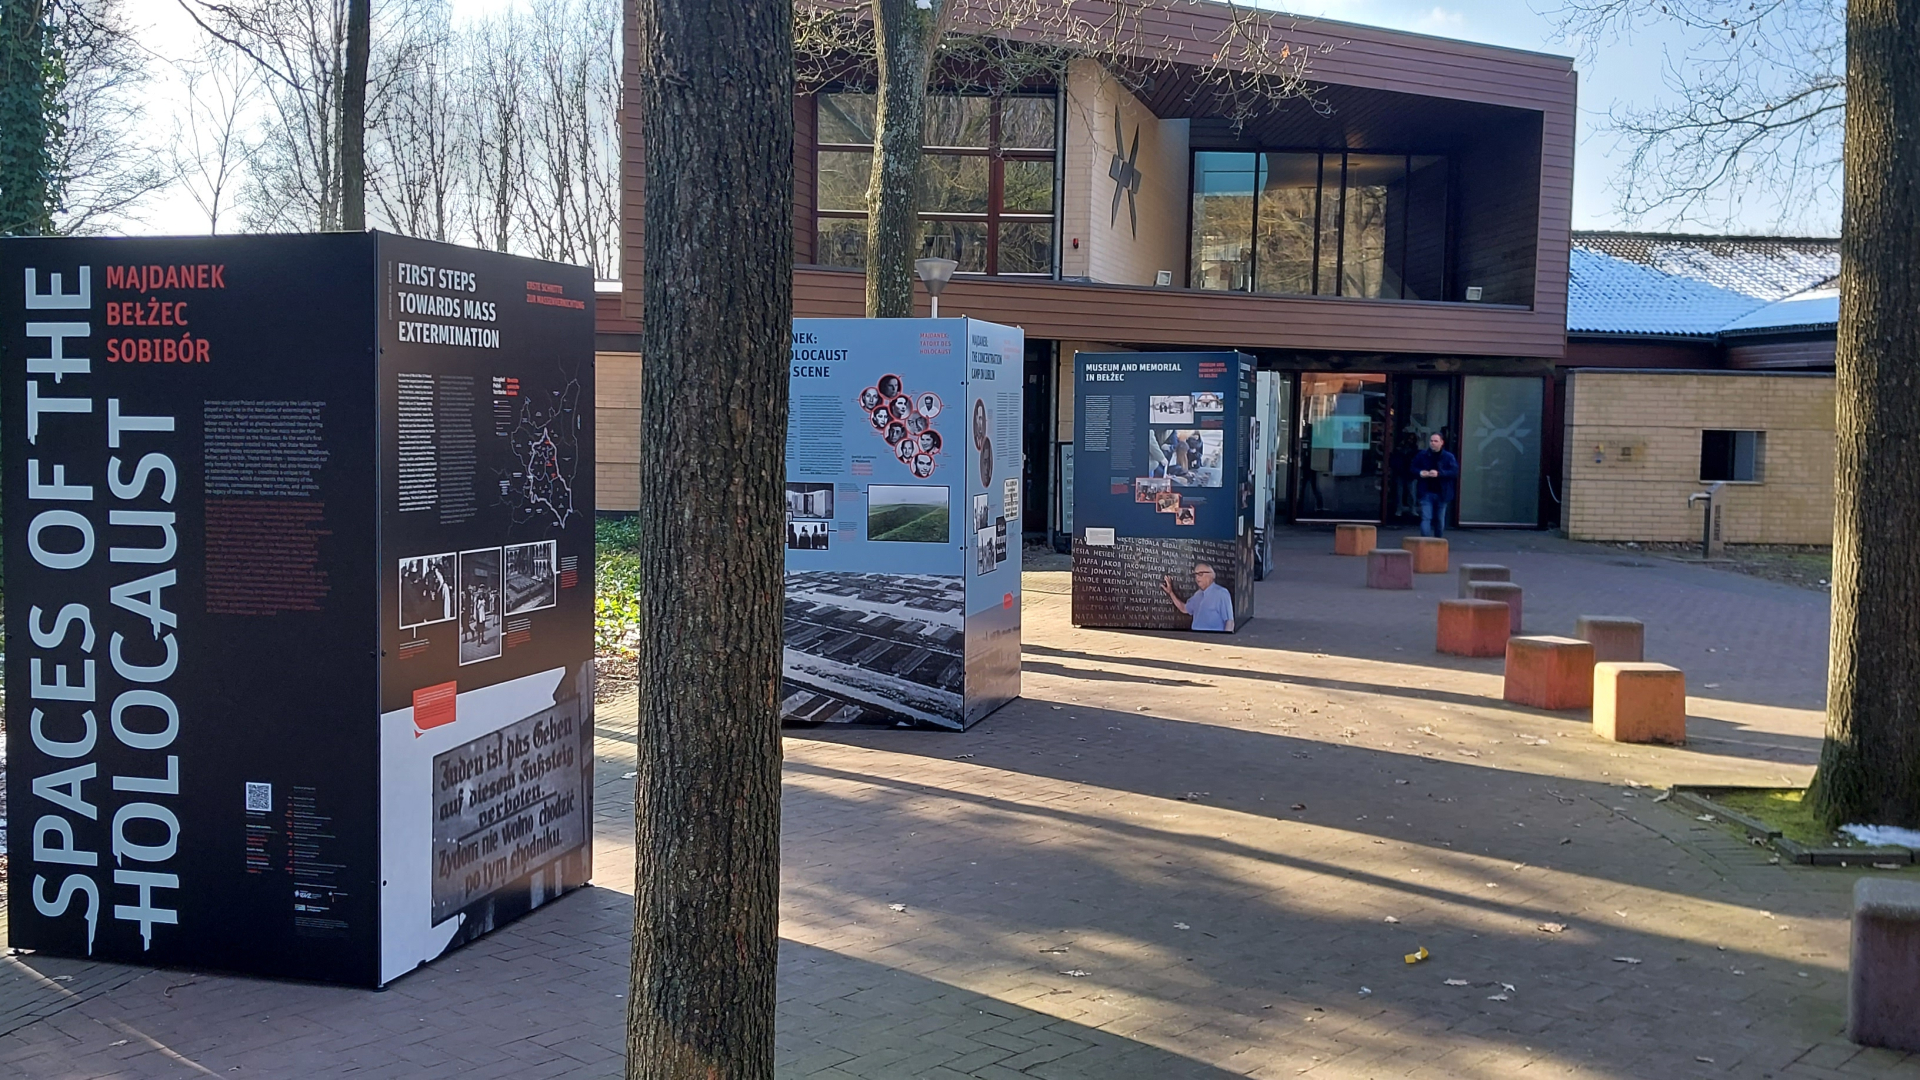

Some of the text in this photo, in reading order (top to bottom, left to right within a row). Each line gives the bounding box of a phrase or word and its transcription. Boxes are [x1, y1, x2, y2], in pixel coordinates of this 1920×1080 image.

[106, 265, 225, 293] MAJDANEK
[398, 262, 476, 292] FIRST STEPS
[106, 297, 188, 325] BEŁŻEC
[398, 292, 496, 322] TOWARDS MASS
[106, 332, 210, 363] SOBIBÓR
[398, 321, 499, 349] EXTERMINATION
[793, 366, 830, 378] SCENE
[1085, 363, 1182, 372] MUSEUM AND MEMORIAL
[1085, 372, 1125, 382] IN BEŁŻEC
[1091, 568, 1121, 576] JONATAN
[25, 265, 100, 955] SPACES OF THE
[107, 398, 181, 951] HOLOCAUST
[440, 755, 484, 791] Juden
[440, 788, 464, 820] auf
[470, 774, 516, 808] diesem
[482, 829, 498, 856] nie
[466, 870, 480, 899] po
